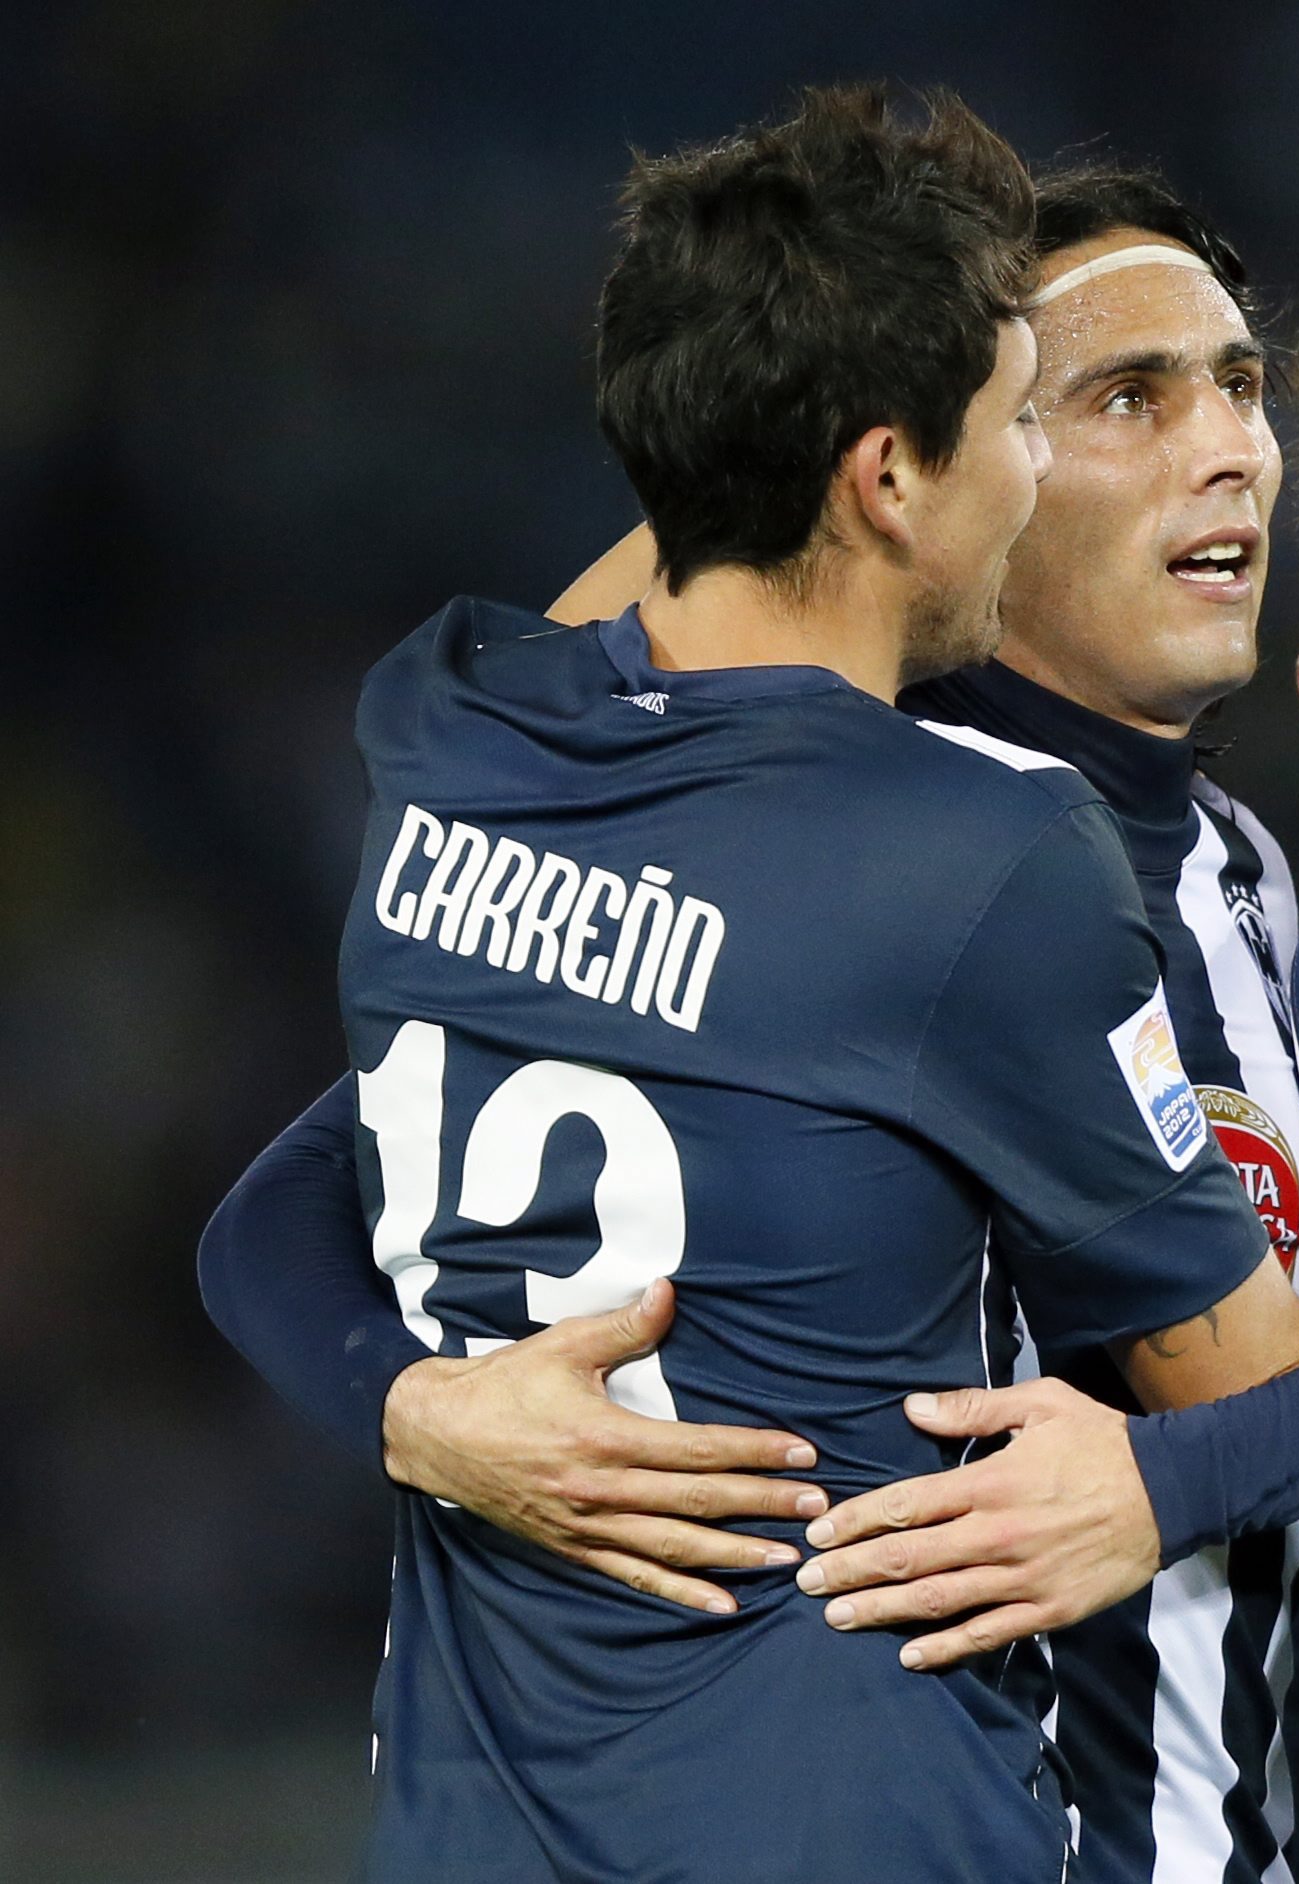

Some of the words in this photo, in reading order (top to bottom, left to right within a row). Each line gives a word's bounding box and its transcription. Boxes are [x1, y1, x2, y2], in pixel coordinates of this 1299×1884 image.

[374, 803, 727, 1033] CARREÑO
[1163, 1107, 1191, 1139] 2012
[1230, 1162, 1280, 1208] TA
[356, 1018, 687, 1422] 13
